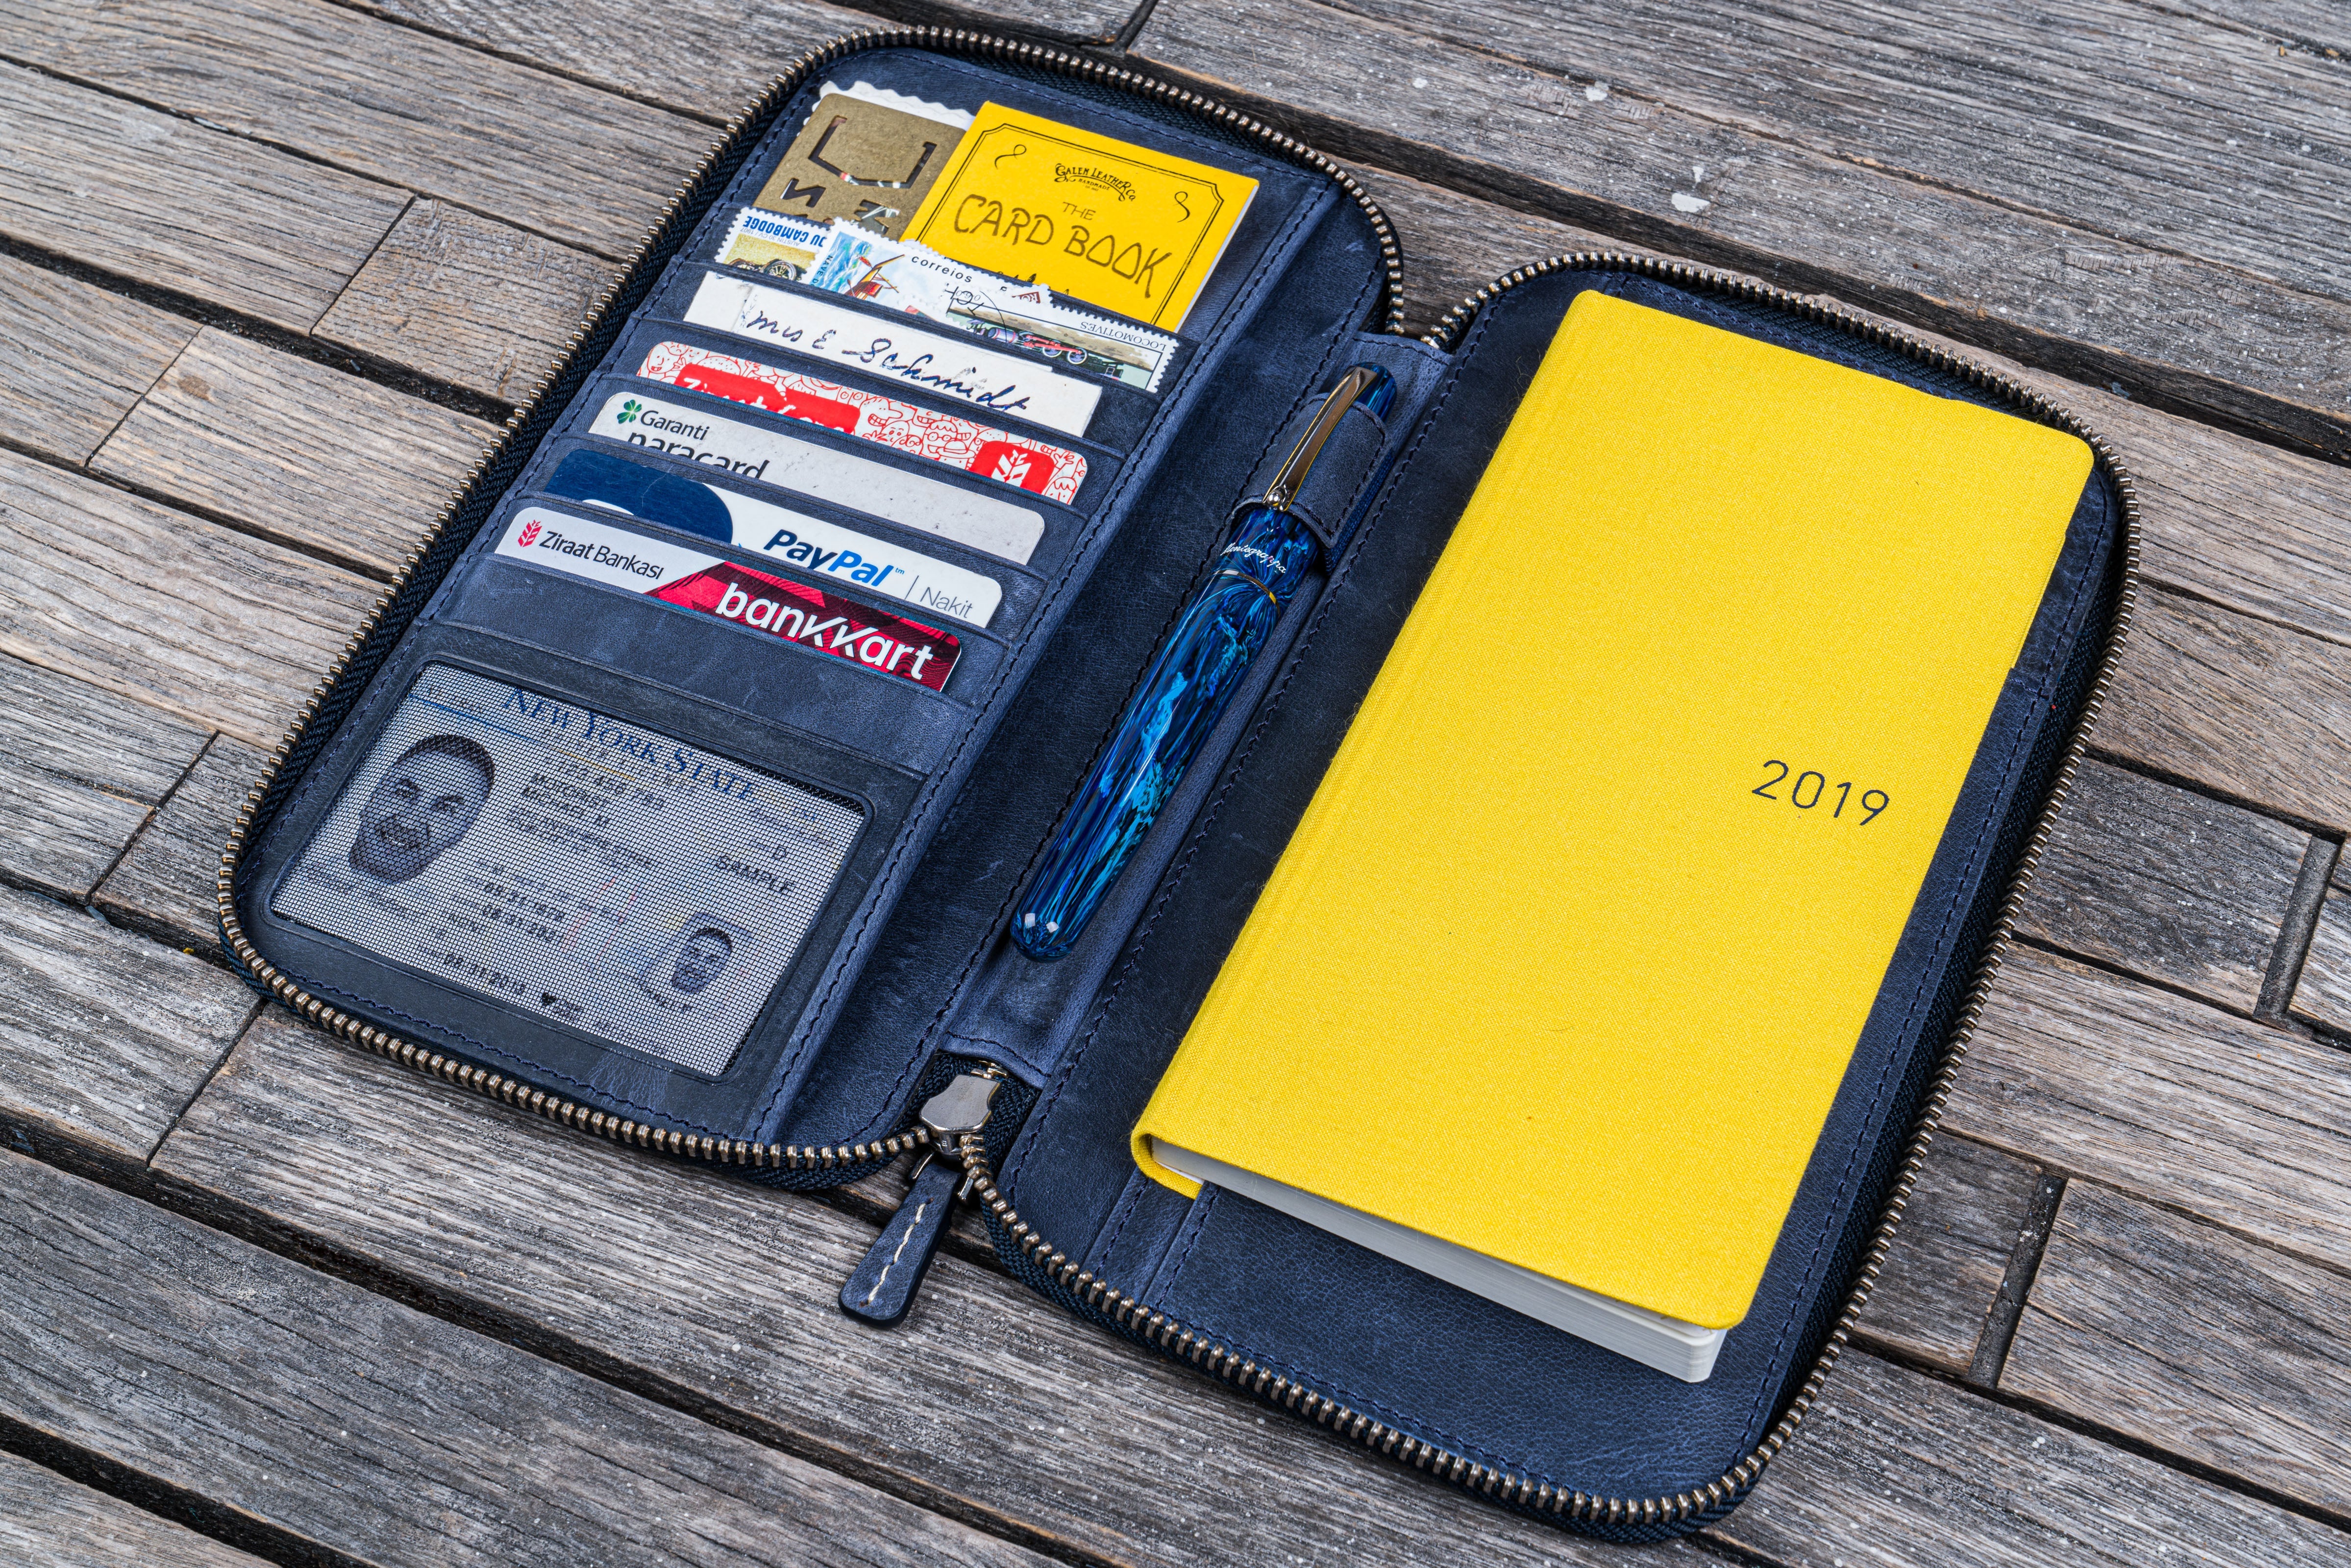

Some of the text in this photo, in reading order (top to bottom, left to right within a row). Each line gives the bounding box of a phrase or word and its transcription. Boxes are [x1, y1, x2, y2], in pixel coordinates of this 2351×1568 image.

[1054, 163, 1089, 182] GALEN
[1091, 168, 1131, 196] LEATHER
[1078, 178, 1110, 191] HANDMADE
[1063, 201, 1096, 220] THE
[743, 216, 809, 243] CAMBODGE
[776, 237, 800, 246] AUSTIN
[954, 194, 1172, 298] CARD BOOK
[817, 255, 833, 276] NAVE
[912, 256, 972, 282] correios
[1080, 321, 1166, 351] LOCOMOTIVES
[641, 410, 710, 441] Garanti
[539, 531, 664, 580] Ziraat Bankası
[763, 529, 894, 587] PayPal
[920, 587, 973, 618] Nakit
[1752, 759, 1890, 826] 2019
[710, 853, 801, 898] SAMPLE
